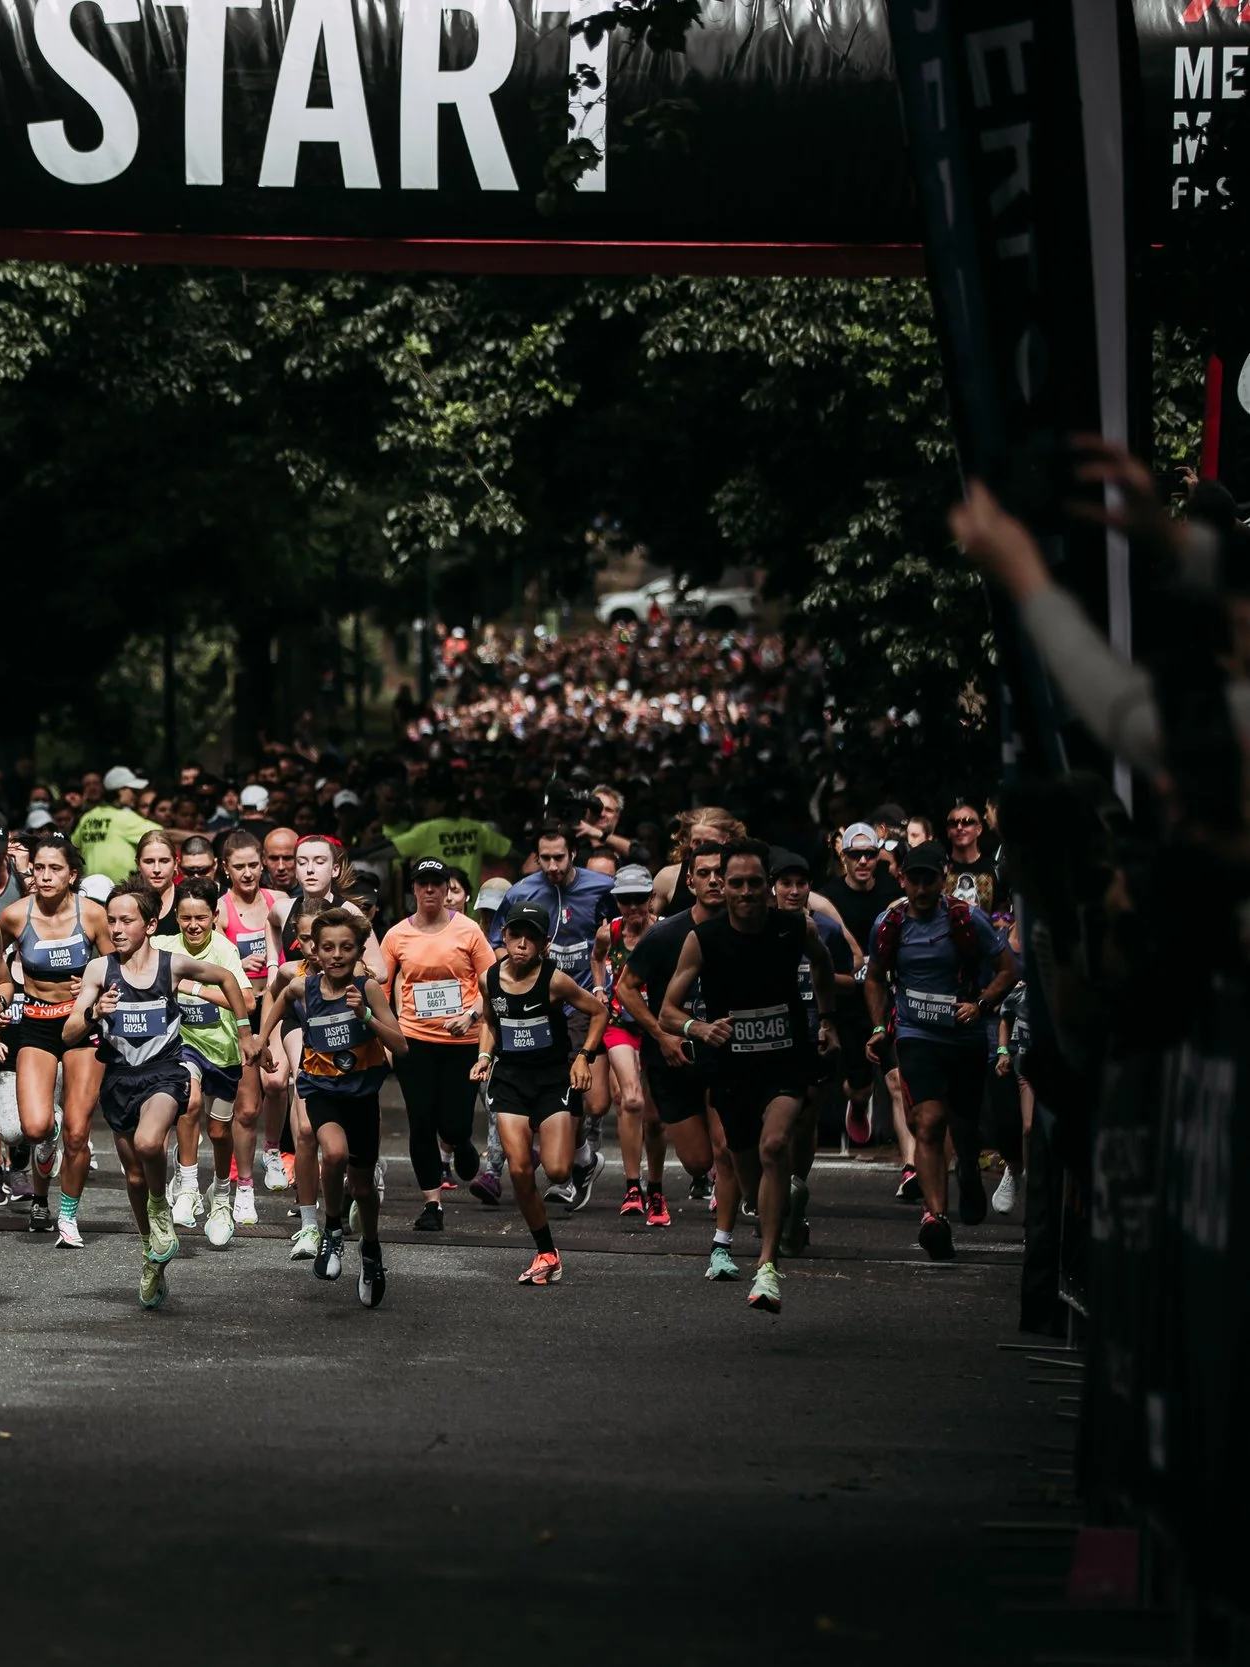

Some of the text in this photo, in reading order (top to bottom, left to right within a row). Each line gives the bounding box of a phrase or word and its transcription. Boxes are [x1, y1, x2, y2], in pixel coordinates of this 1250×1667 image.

[27, 0, 622, 192] START
[438, 829, 478, 844] EVENT
[49, 949, 71, 959] LAURA
[50, 957, 72, 967] 60282
[426, 990, 446, 999] ALICIA
[39, 1004, 72, 1017] NIKE
[908, 998, 951, 1014] LAYLA DIMECH
[122, 1013, 147, 1023] FINN K
[123, 1023, 148, 1033] 60254
[324, 1024, 350, 1038] JASPER
[513, 1029, 532, 1038] ZACH
[734, 1017, 785, 1041] 60346
[327, 1034, 350, 1047] 60247
[513, 1037, 535, 1047] 60246
